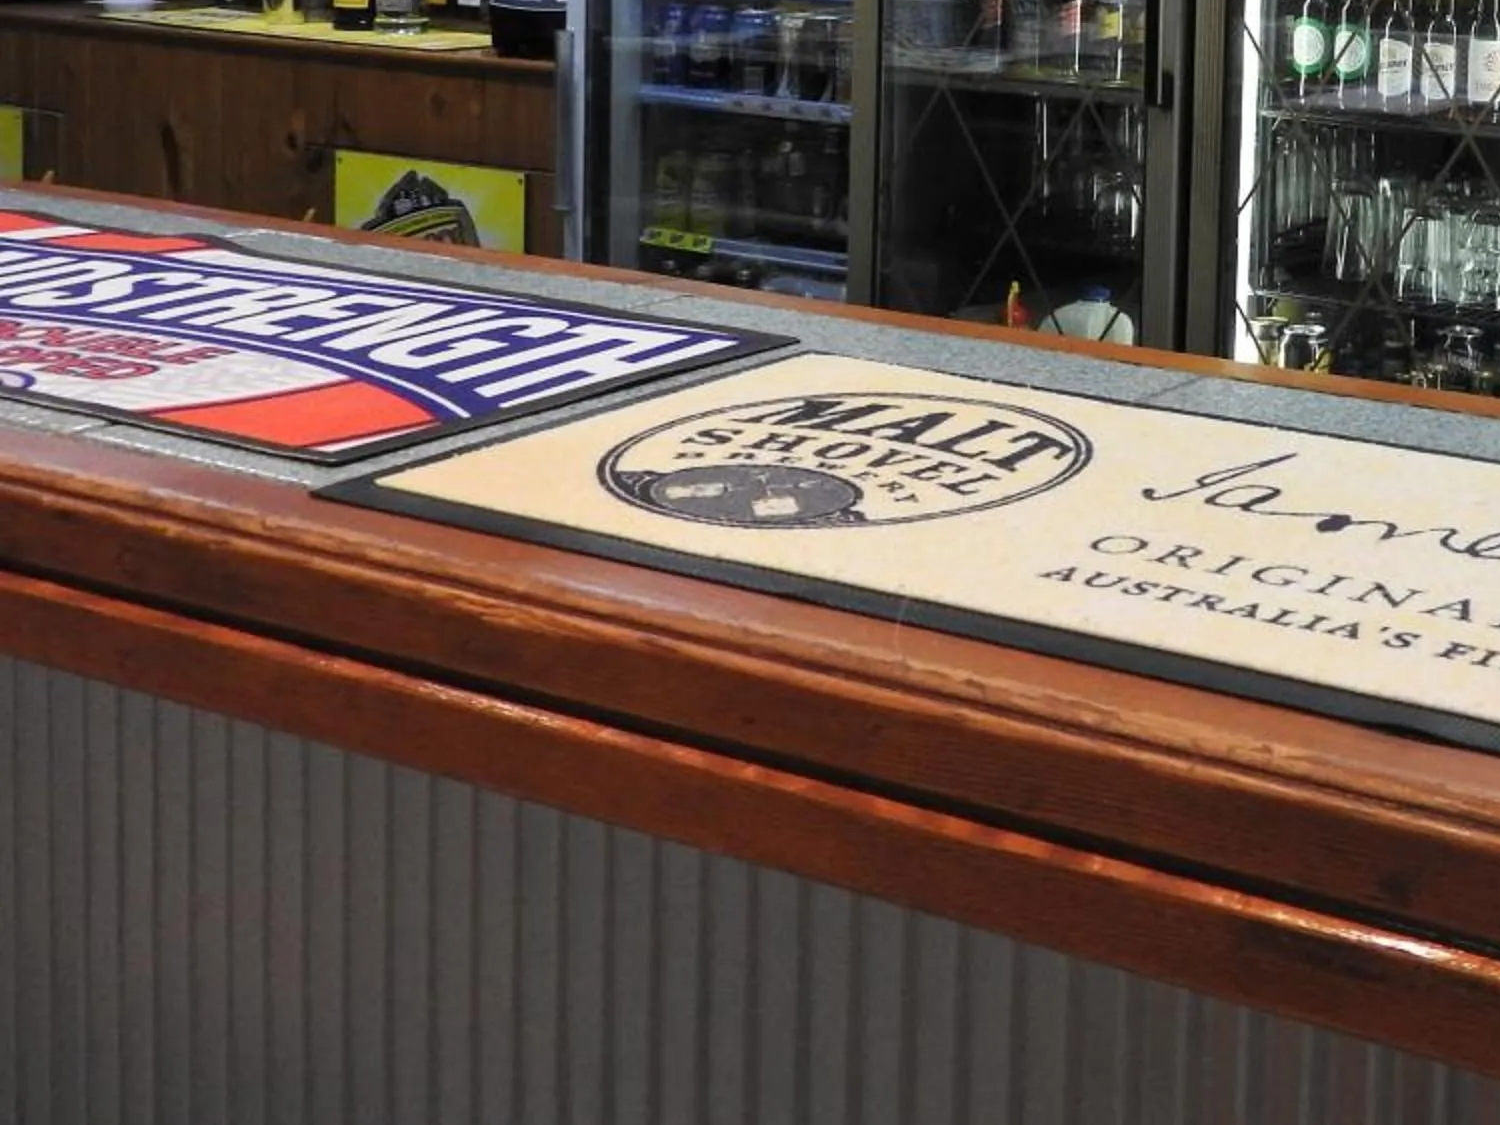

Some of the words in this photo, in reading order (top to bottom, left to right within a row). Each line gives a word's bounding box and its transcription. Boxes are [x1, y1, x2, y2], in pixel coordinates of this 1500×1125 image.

[681, 428, 1000, 496] SHOVEL
[733, 399, 1073, 473] MALT
[1038, 566, 1423, 650] AUSTRALIA'S
